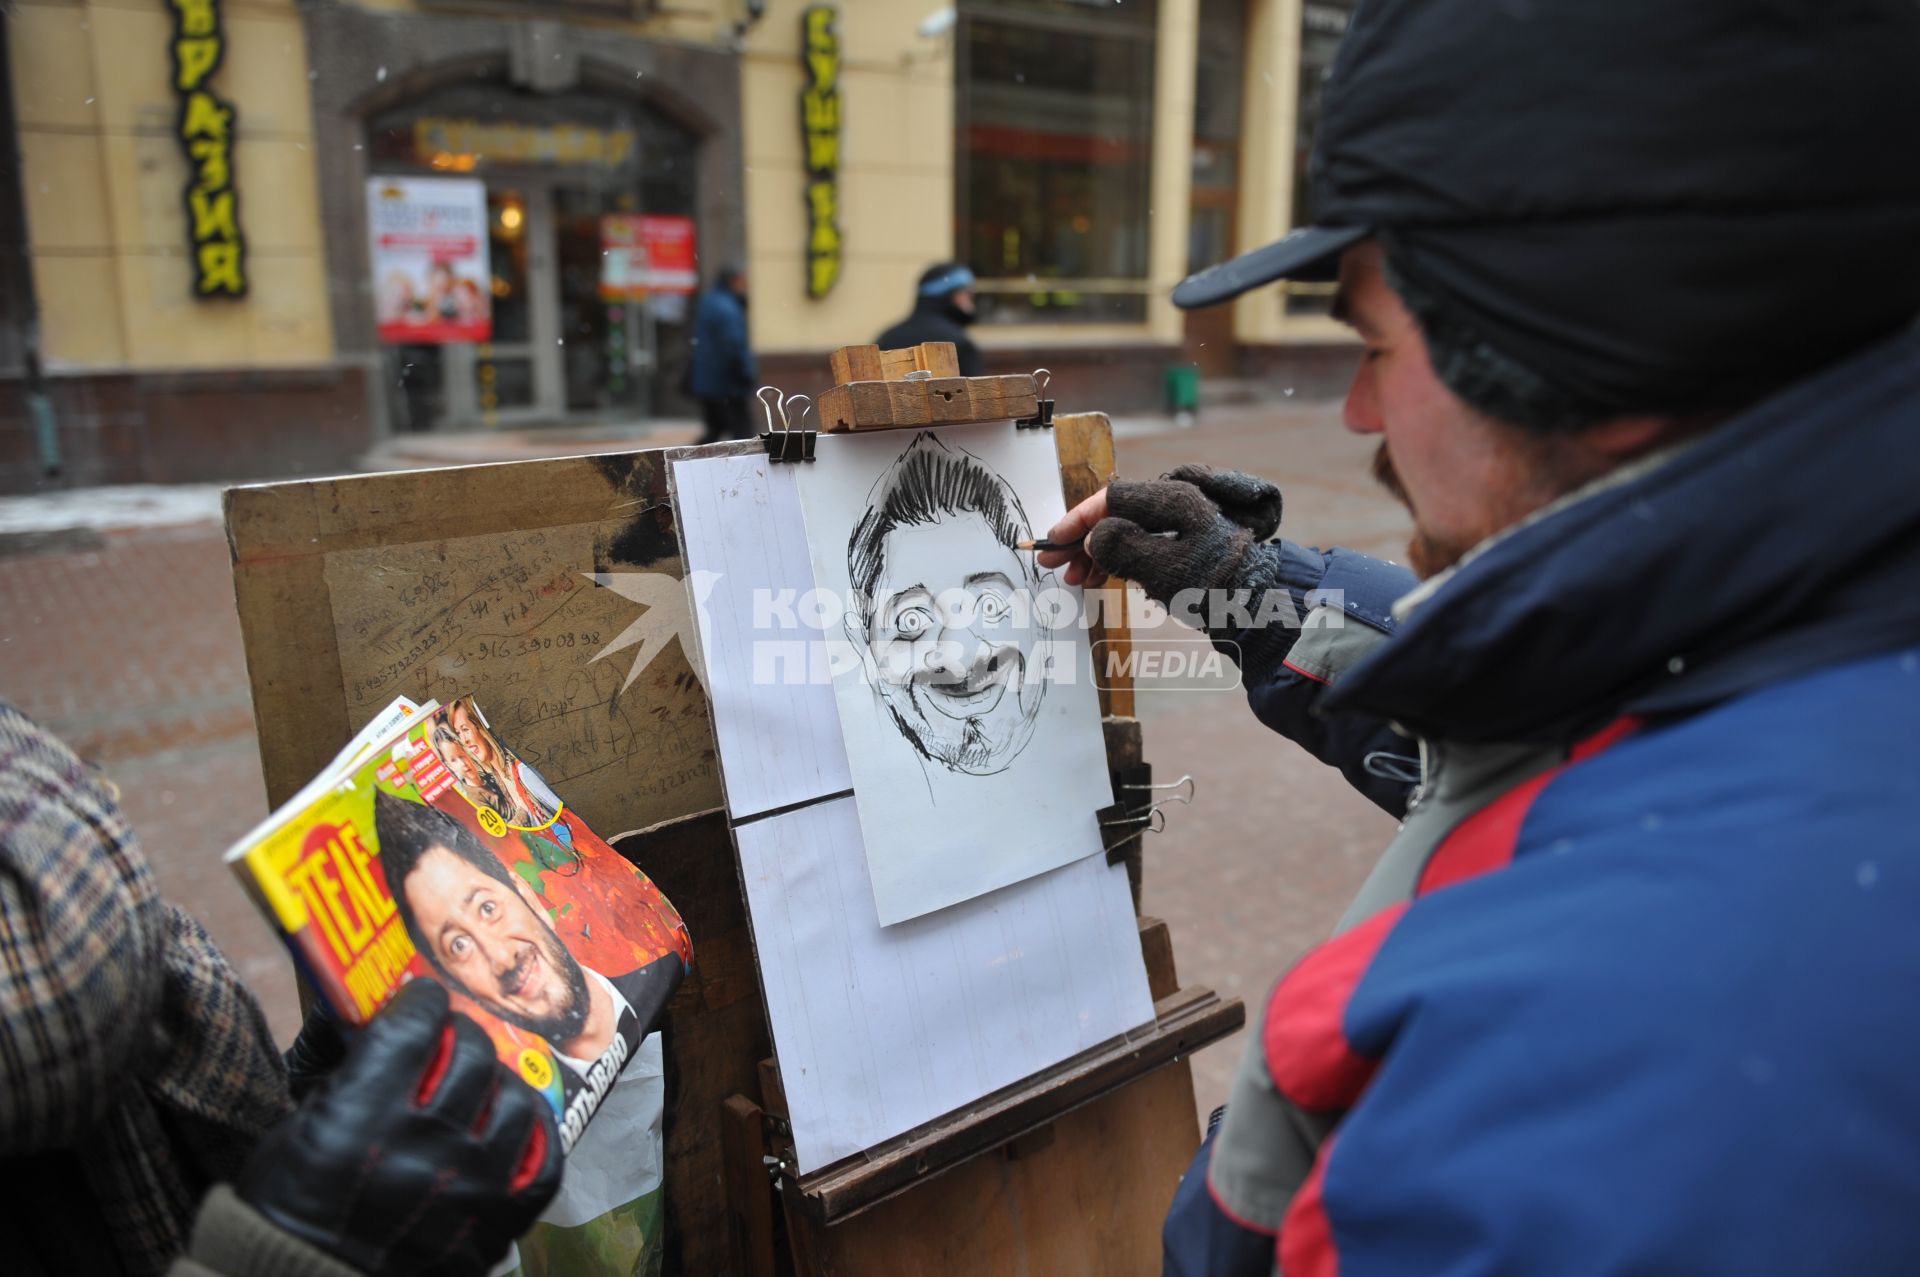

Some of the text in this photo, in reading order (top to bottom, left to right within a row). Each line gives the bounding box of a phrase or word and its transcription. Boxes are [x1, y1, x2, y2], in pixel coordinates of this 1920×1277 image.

[480, 809, 498, 828] 20
[286, 824, 398, 967] ТЕЛЕ
[344, 915, 417, 1021] ПРОГРАММ
